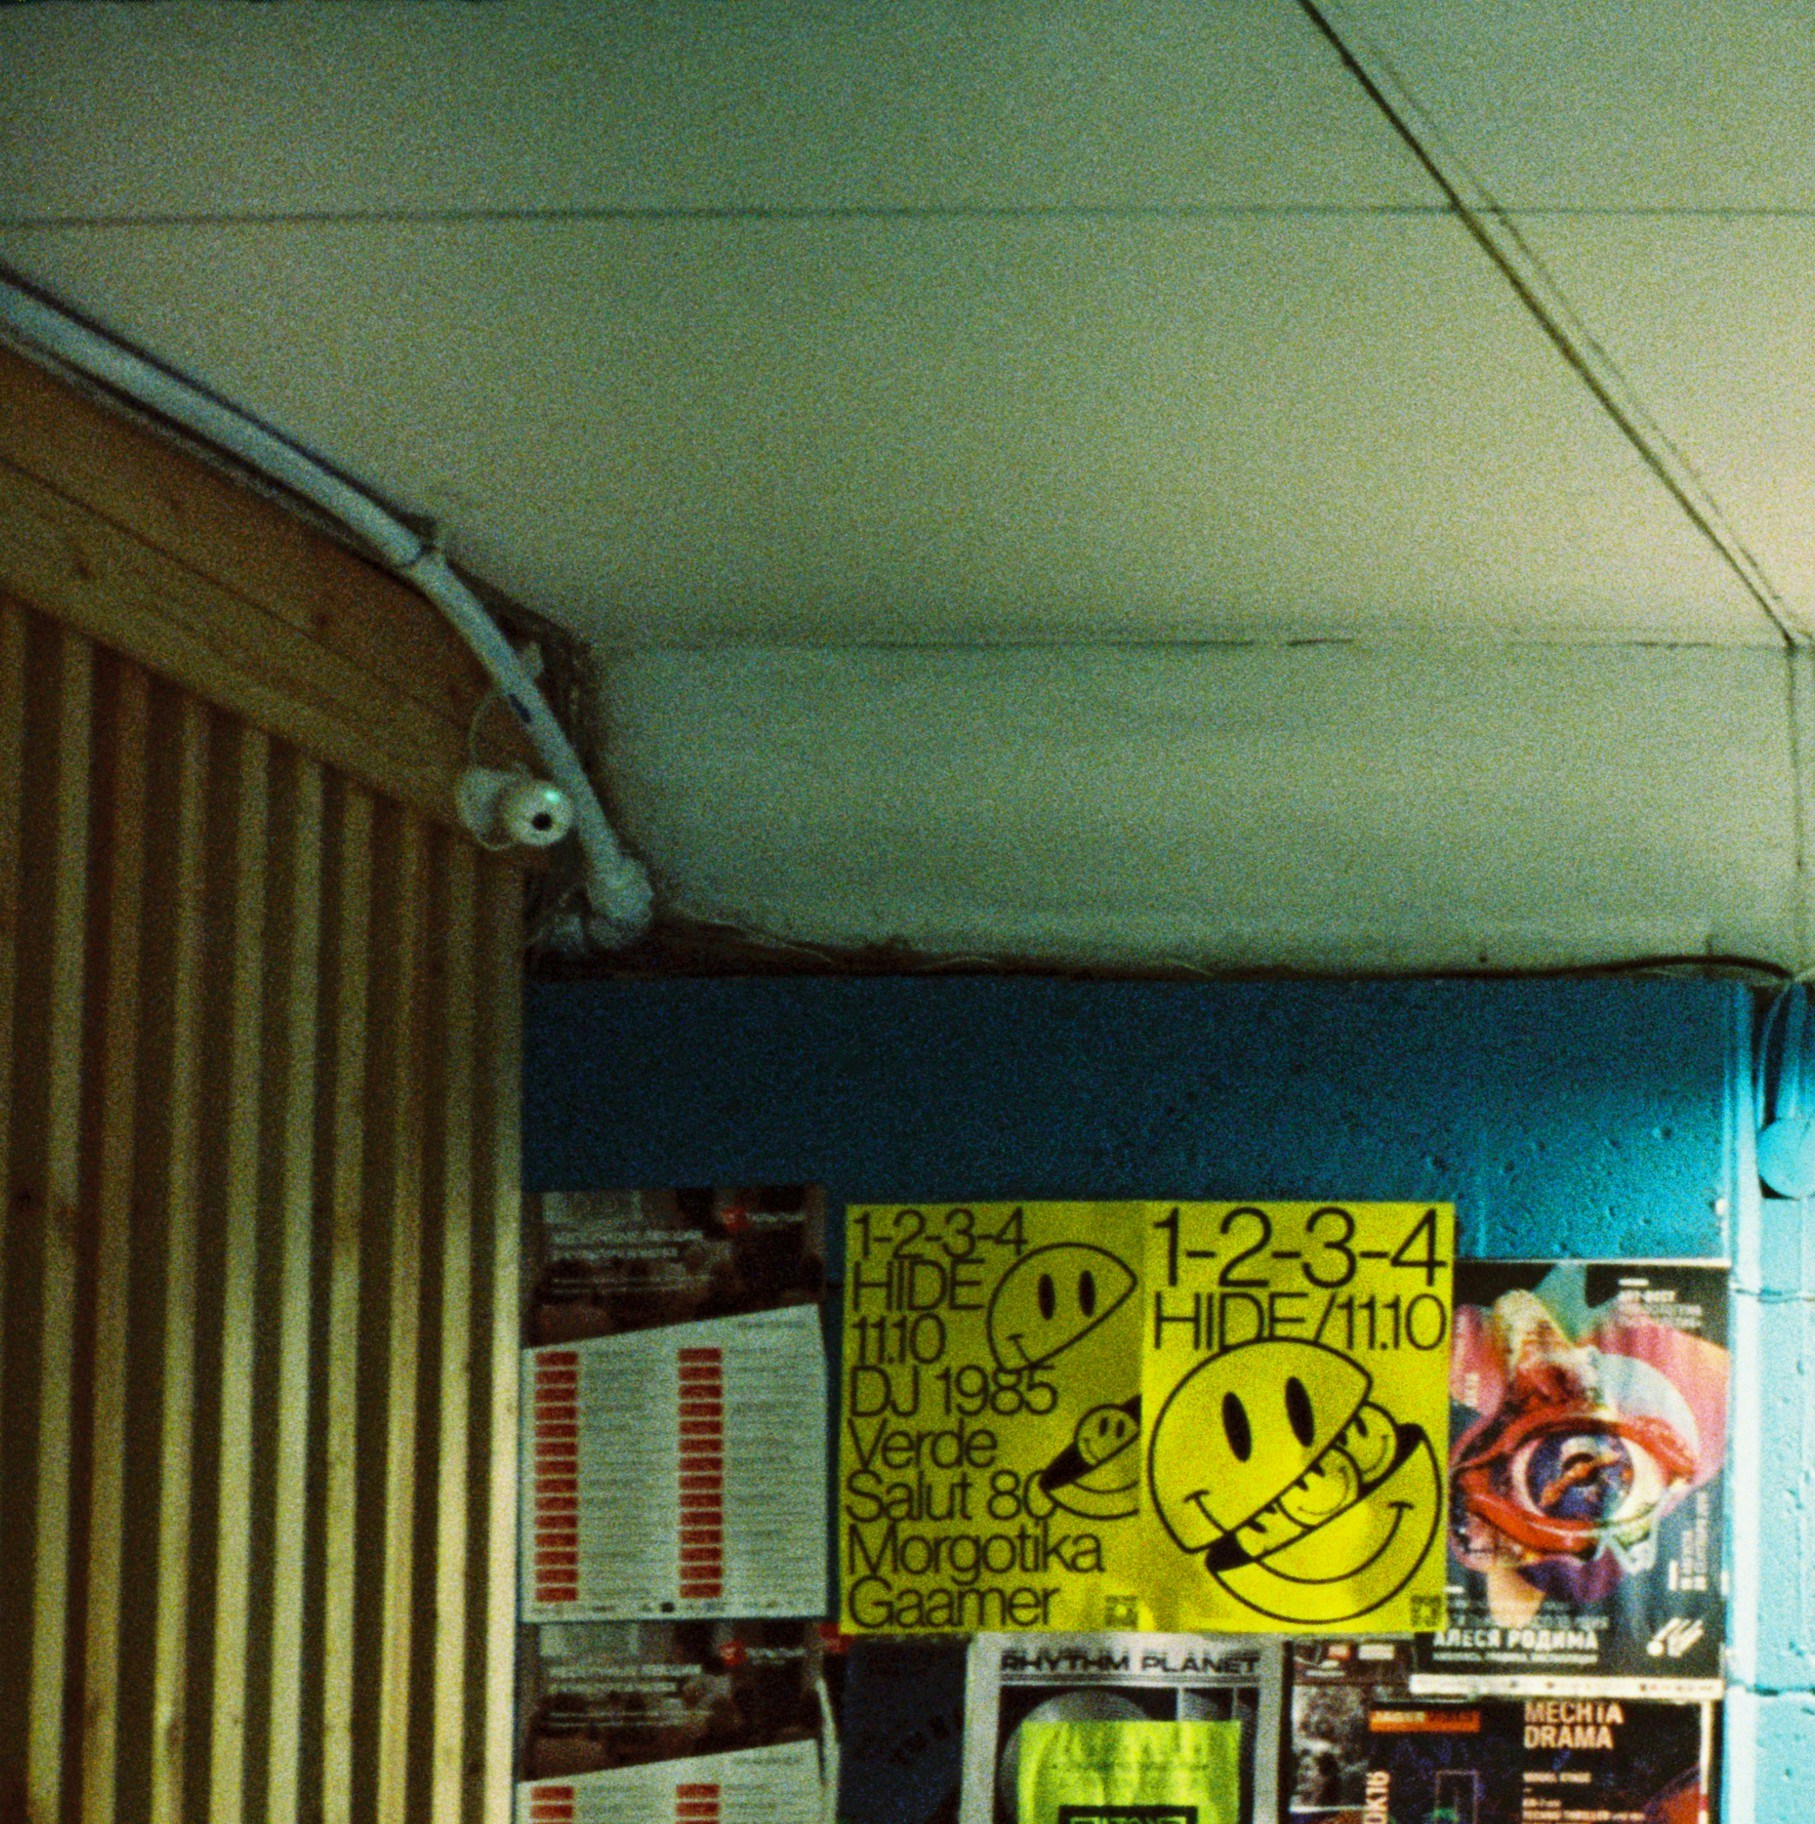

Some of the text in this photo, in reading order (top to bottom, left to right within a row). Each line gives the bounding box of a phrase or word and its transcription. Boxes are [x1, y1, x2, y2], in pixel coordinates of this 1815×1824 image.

[855, 1207, 1026, 1256] 1-2-3-4
[1154, 1208, 1446, 1288] 1-2-3-4
[854, 1260, 984, 1311] HIDE
[854, 1314, 946, 1364] 11.10
[1154, 1293, 1446, 1351] HIDE/11.10
[851, 1366, 1058, 1416] DJ 1985
[848, 1419, 996, 1470] Verde
[847, 1471, 972, 1521] Salut
[848, 1524, 1104, 1584] Morgotika
[848, 1574, 1061, 1629] Gaamer
[1001, 1650, 1260, 1674] RHYTHM PLANET
[1523, 1726, 1614, 1750] DRAMA
